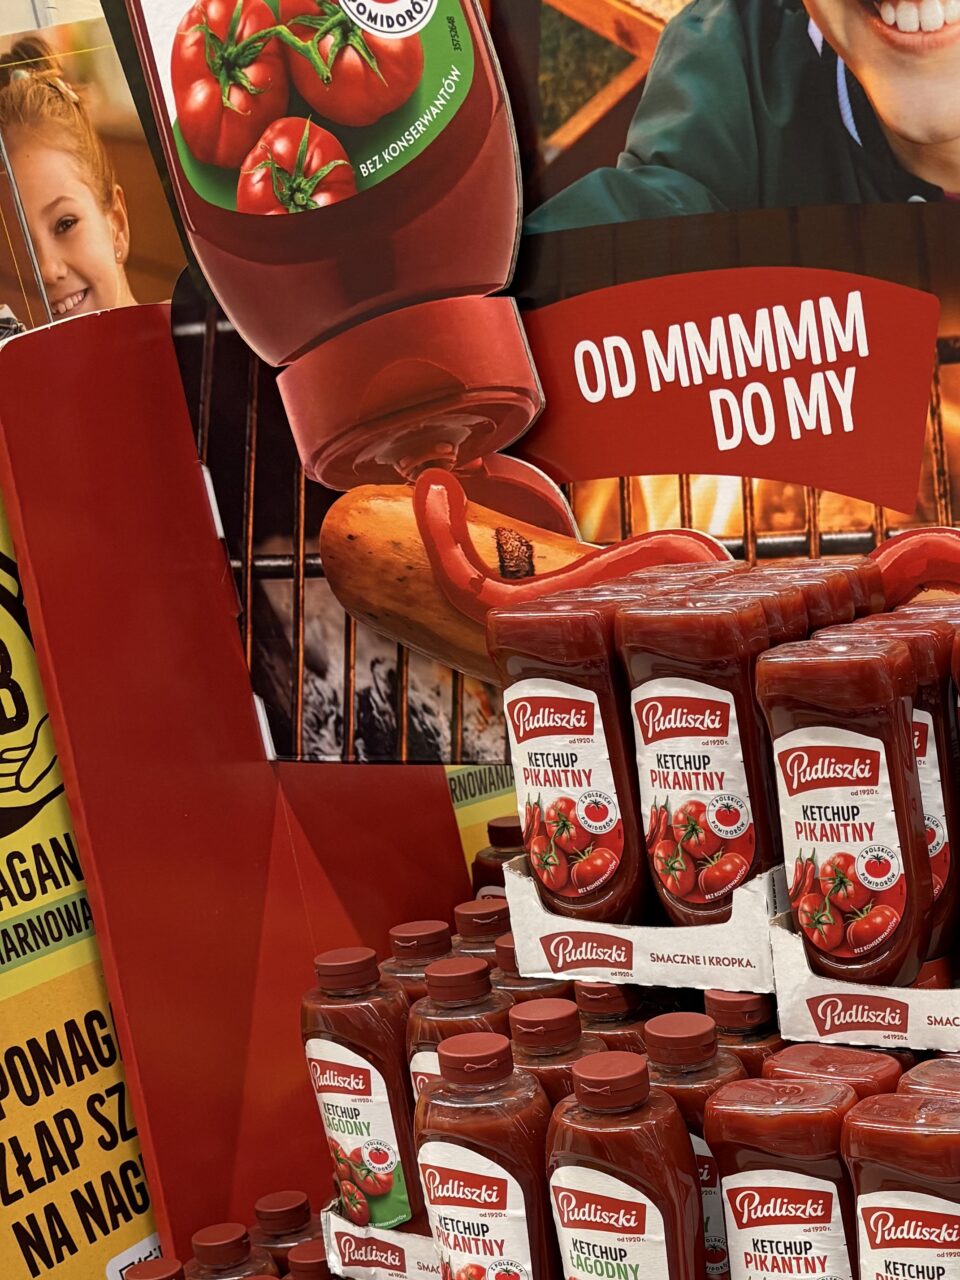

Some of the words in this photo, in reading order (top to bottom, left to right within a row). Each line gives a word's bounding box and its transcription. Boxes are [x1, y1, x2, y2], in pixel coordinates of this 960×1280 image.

[352, 0, 428, 28] OMIDORÓ
[359, 156, 383, 177] BEZ
[382, 65, 462, 164] KONSERWANTÓW
[574, 336, 636, 403] OD
[642, 290, 869, 392] MMMMM
[709, 382, 775, 451] DO
[783, 366, 856, 440] MY
[514, 701, 587, 737] Pudliszki
[528, 752, 578, 768] KETCHUP
[787, 751, 872, 789] Pudliszki
[523, 768, 593, 787] PIKANTNY
[802, 805, 860, 822] KETCHUP
[795, 822, 875, 842] PIKANTNY
[0, 898, 94, 965] ARNOWA
[550, 935, 627, 967] Pudliszki
[650, 952, 700, 966] SMACZNE
[703, 956, 707, 966] I
[708, 956, 756, 969] KROPKA.
[817, 997, 902, 1030] Pudliszki
[0, 1001, 123, 1122] POMAG
[311, 1061, 366, 1091] Pudliszki
[0, 1108, 84, 1207] ZŁAP
[425, 1168, 499, 1203] Pudliszki
[11, 1201, 79, 1279] NA
[71, 1154, 151, 1244] NAG
[438, 1215, 489, 1237] KETCHUP
[558, 1192, 638, 1228] Pudliszki
[435, 1226, 505, 1257] PIKANTNY
[869, 1211, 959, 1244] Pudliszki
[569, 1249, 640, 1280] ŁAGODNY
[572, 1238, 628, 1262] KETCHUP
[884, 1260, 946, 1280] KETCHUP
